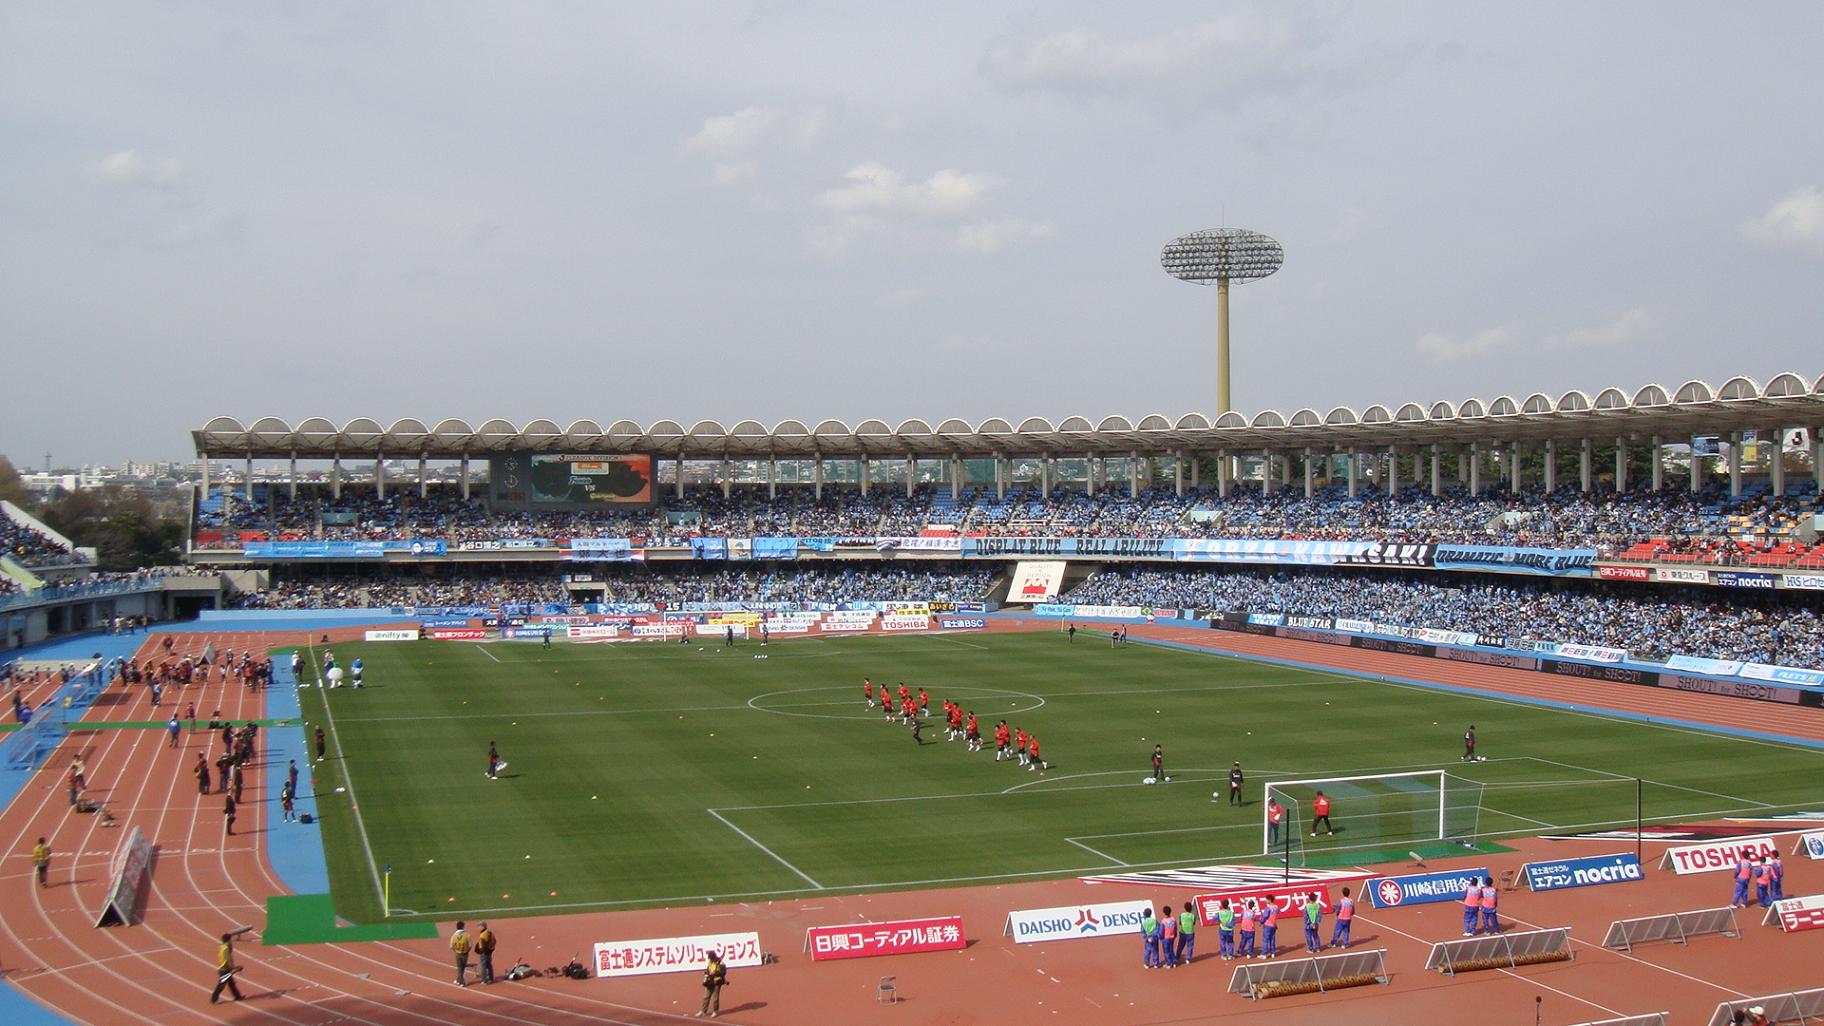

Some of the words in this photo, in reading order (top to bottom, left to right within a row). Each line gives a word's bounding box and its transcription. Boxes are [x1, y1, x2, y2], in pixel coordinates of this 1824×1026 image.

[975, 538, 1026, 556] DISPLAY
[1030, 539, 1061, 556] BLUE
[1076, 539, 1108, 556] REAL
[1112, 539, 1164, 557] ABILITY
[1436, 550, 1504, 564] DRAMATIC
[1513, 553, 1553, 569] MORE
[1739, 575, 1773, 588] nocria
[884, 621, 926, 629] TOSHIBA
[943, 620, 984, 628] 富士通BSC
[1288, 617, 1309, 627] BLUE
[1309, 618, 1331, 629] STAR
[1450, 648, 1480, 661] SHOUT!
[1490, 654, 1520, 667] SHOOT!
[1557, 661, 1591, 676] SHOUT!
[1605, 668, 1640, 682] SHOOT!
[1678, 676, 1717, 691] SHOUT!
[1735, 684, 1777, 699] SHOOT!
[1674, 843, 1773, 870] TOSHIBA
[1534, 875, 1572, 888] エアコン
[1573, 858, 1640, 884] nocria
[1781, 901, 1804, 911] 富士通
[1019, 918, 1072, 935] DAISHO
[815, 925, 961, 953] 日興コーディアル証券
